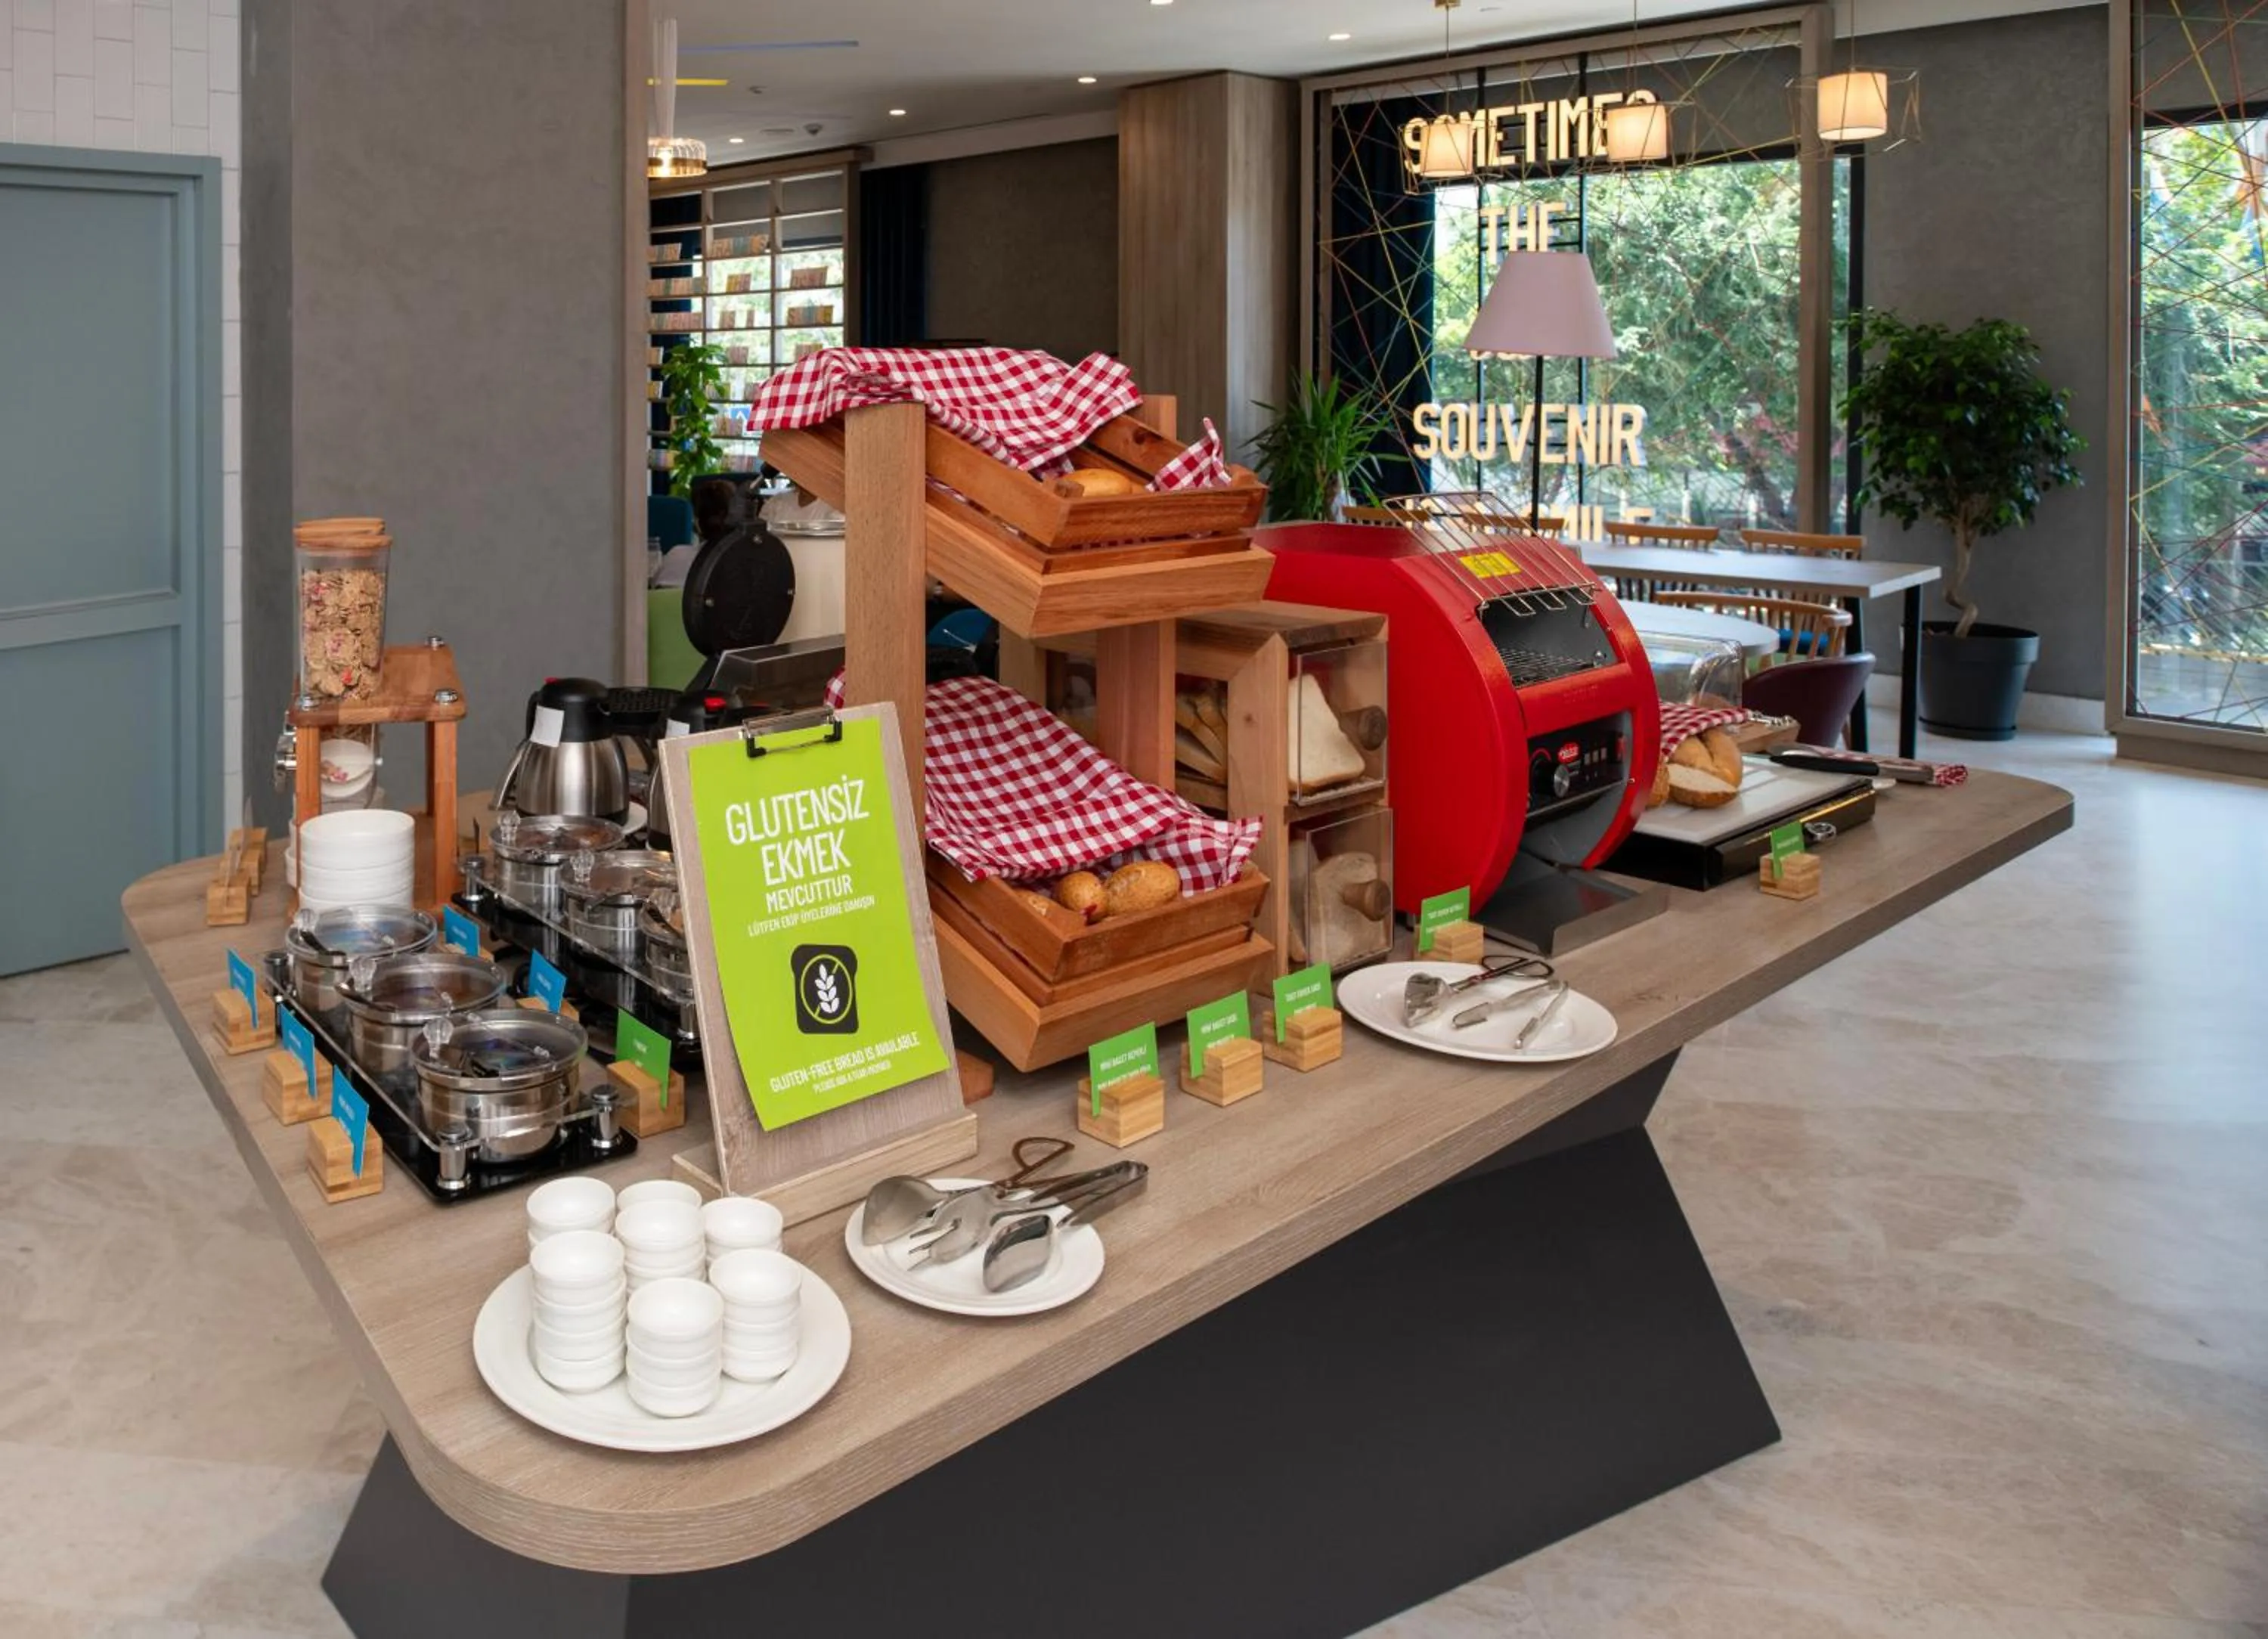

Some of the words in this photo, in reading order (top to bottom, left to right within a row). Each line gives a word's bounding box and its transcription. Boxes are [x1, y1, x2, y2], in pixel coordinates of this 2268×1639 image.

[1403, 89, 1658, 175] SMETIME
[1412, 403, 1644, 466] SOUVENIR
[725, 774, 869, 846] GLUTENSİZ
[761, 828, 851, 886] EKMEK
[765, 874, 854, 914] MEVCUTTUR
